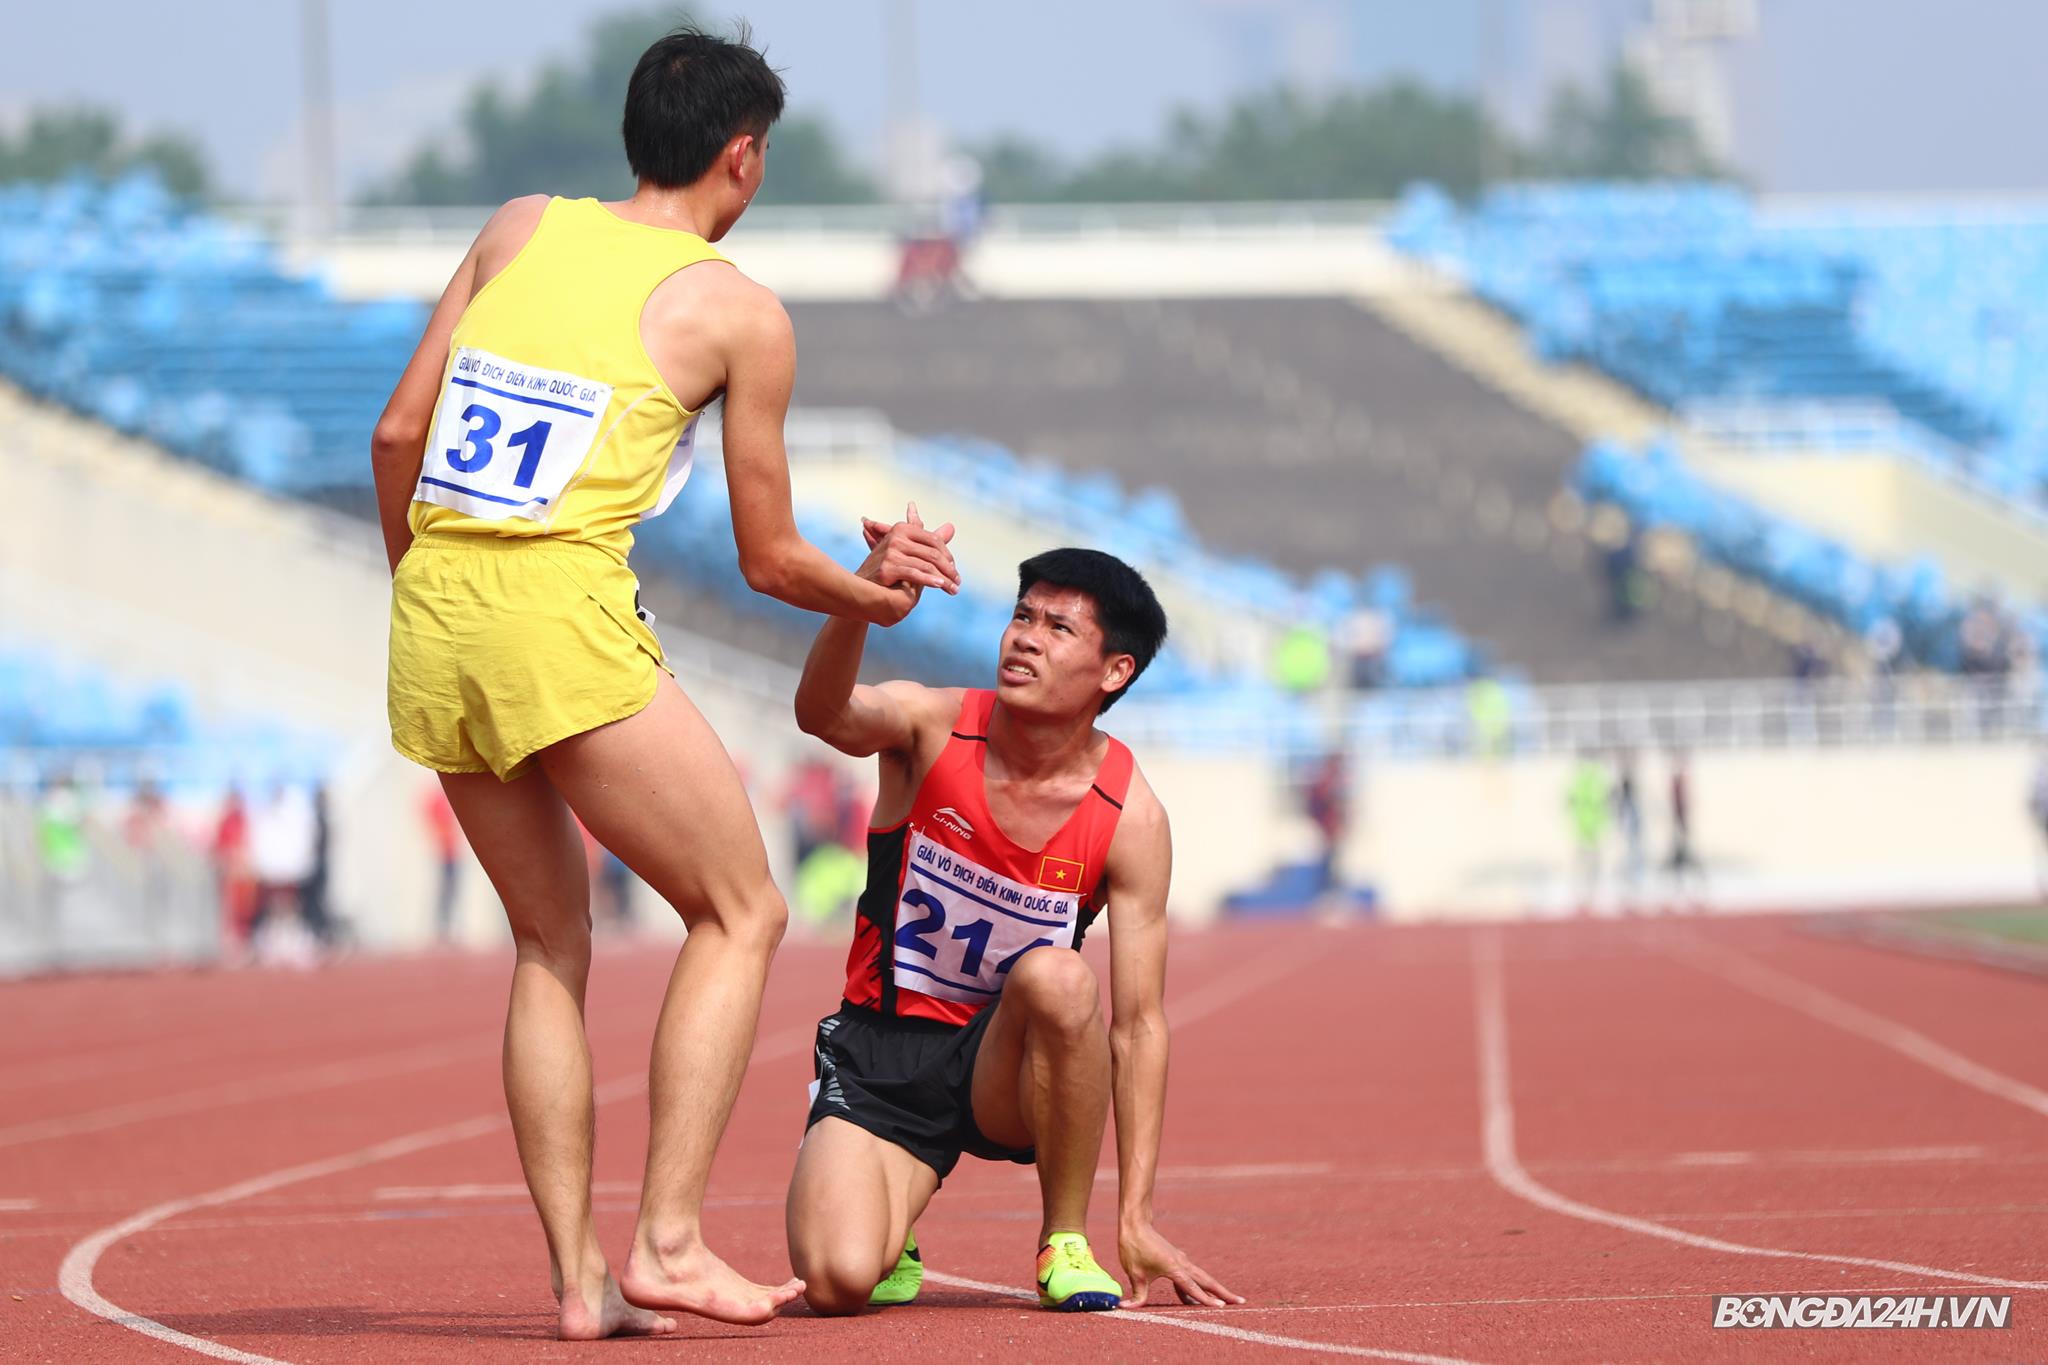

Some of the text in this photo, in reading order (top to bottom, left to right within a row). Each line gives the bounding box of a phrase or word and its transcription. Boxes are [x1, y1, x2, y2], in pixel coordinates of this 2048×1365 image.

[527, 375, 549, 392] KINH
[580, 387, 597, 403] GIA
[446, 404, 552, 488] 31
[932, 812, 972, 840] LI-NING
[999, 886, 1023, 906] KINH
[1024, 894, 1052, 913] QUỐC
[1053, 900, 1069, 915] GIA
